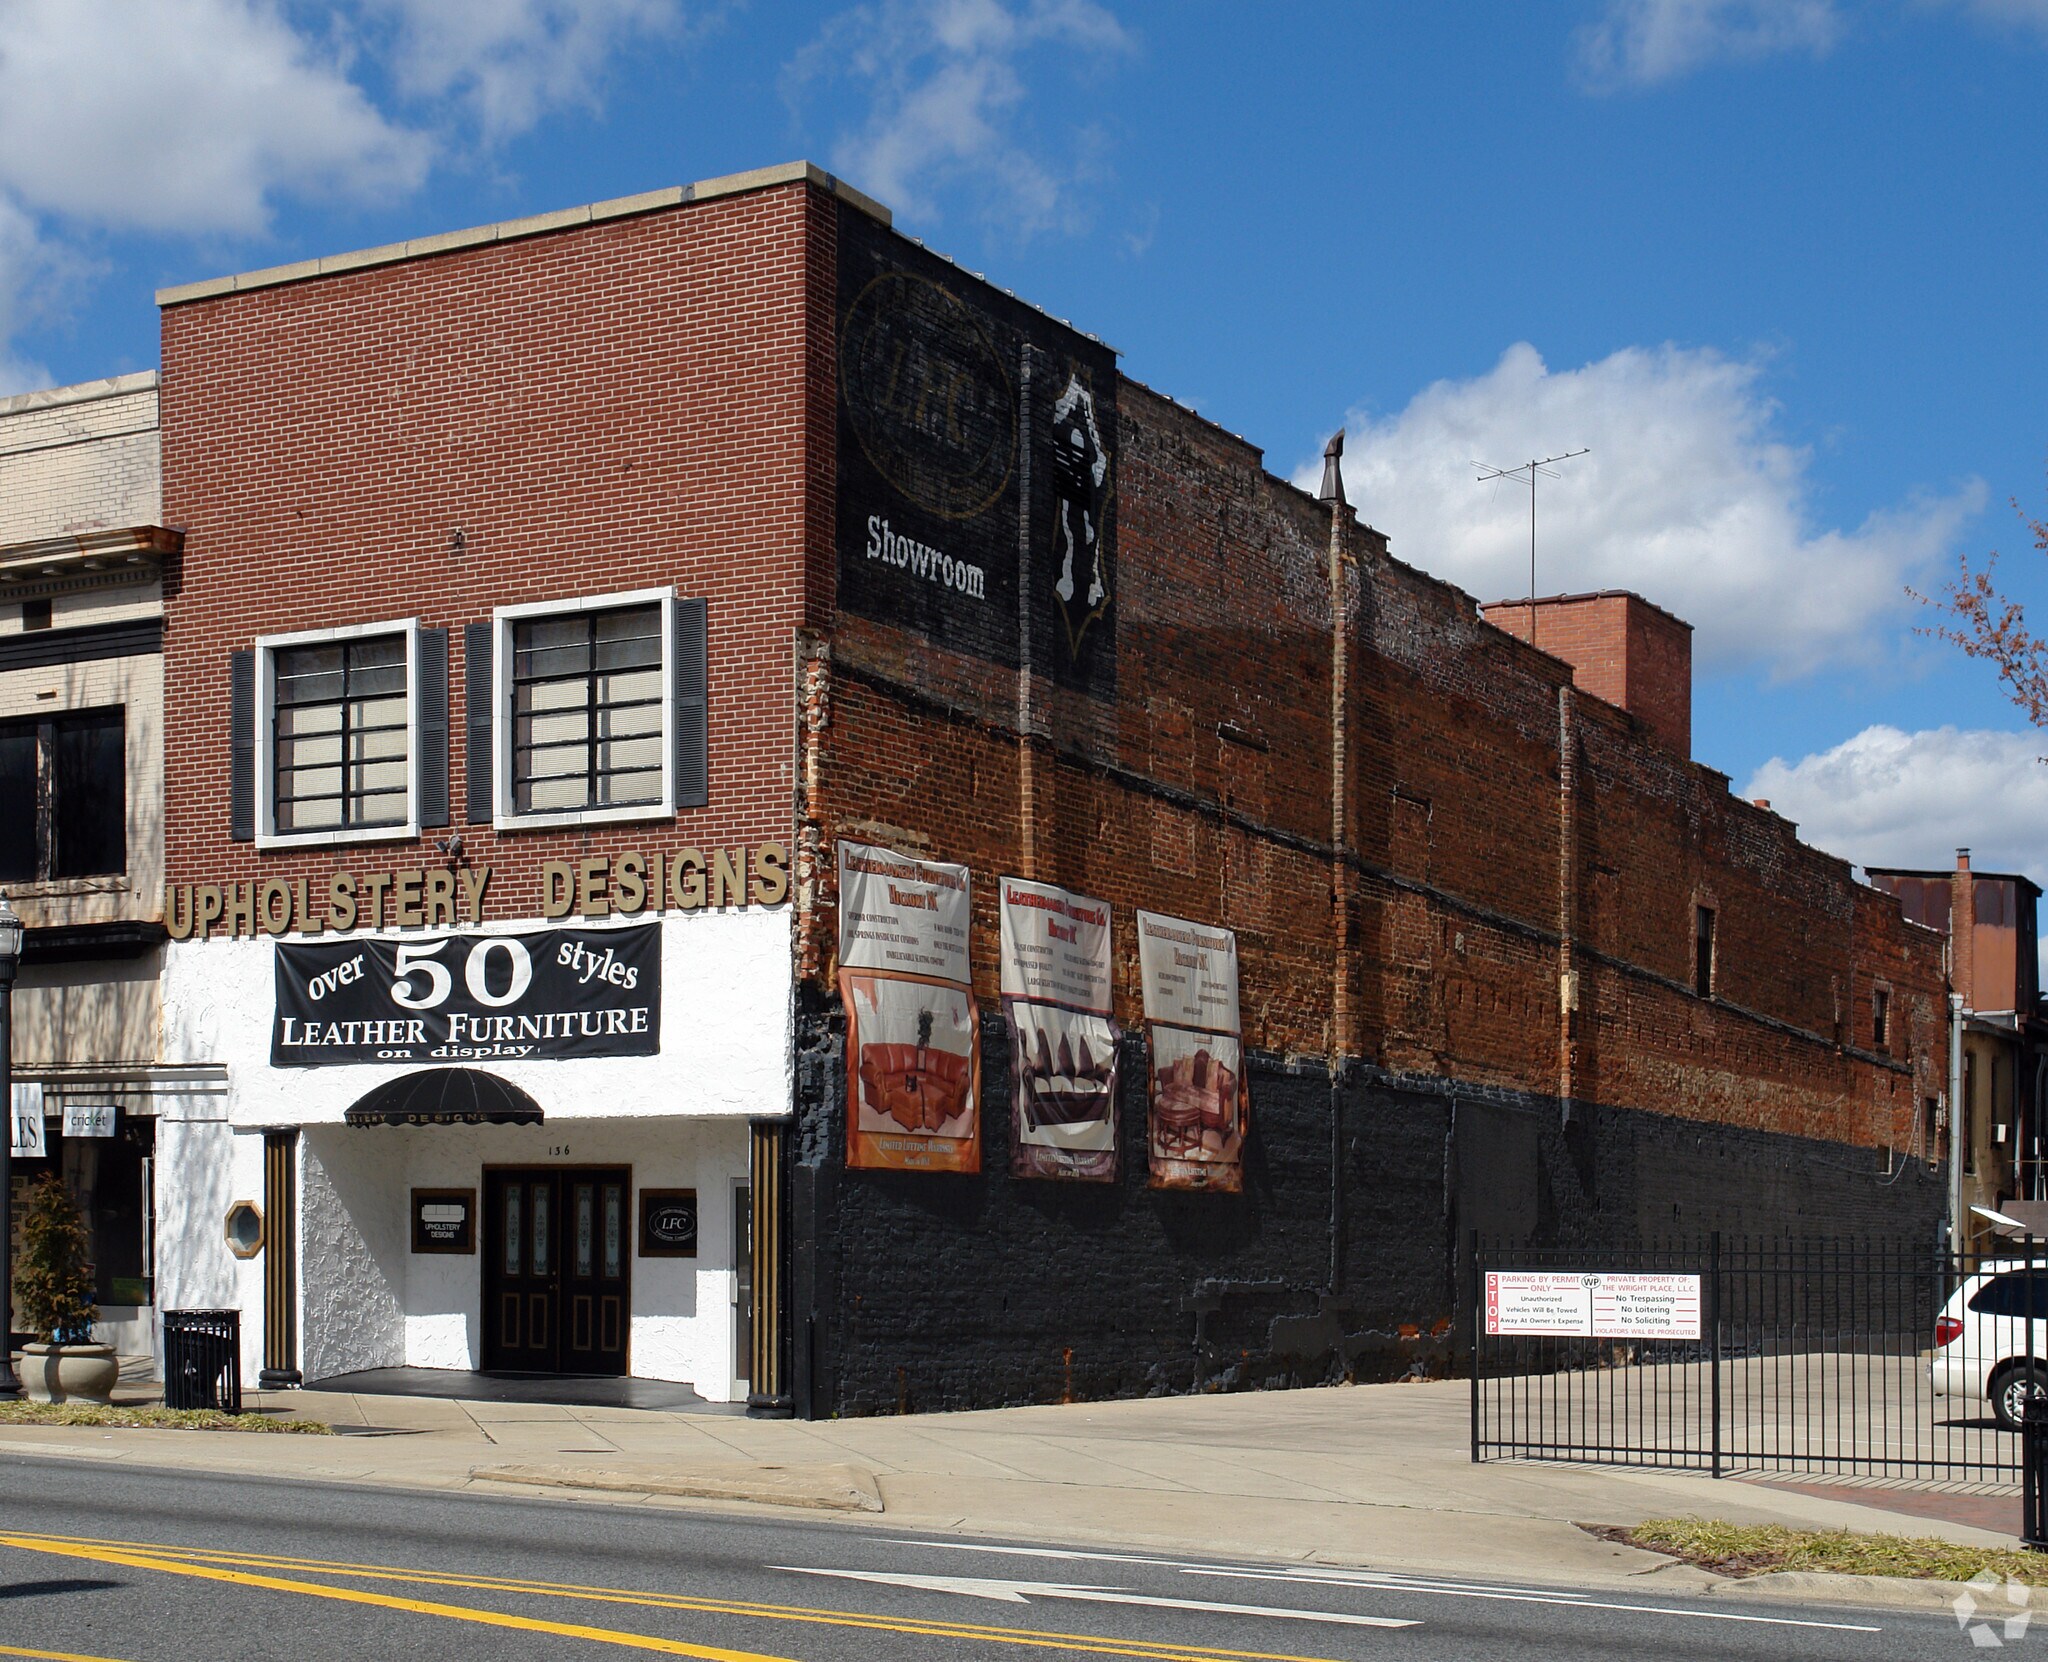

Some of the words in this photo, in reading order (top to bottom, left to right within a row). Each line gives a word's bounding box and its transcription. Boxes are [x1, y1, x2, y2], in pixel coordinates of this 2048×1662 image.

[866, 514, 985, 601] Showroom
[166, 866, 491, 939] UPHOLSTERY
[543, 842, 790, 918] DESIGNS
[308, 952, 365, 1001] over
[391, 937, 533, 1010] 50
[556, 940, 639, 990] styles
[281, 1017, 427, 1046] LEATHER
[445, 1007, 649, 1043] FURNITURE
[377, 1048, 412, 1058] on
[430, 1045, 534, 1060] display
[71, 1110, 107, 1126] cricket
[408, 1113, 488, 1123] DESIGNS
[548, 1144, 570, 1156] 136
[424, 1223, 461, 1231] UPHOLSTERY
[661, 1217, 687, 1230] LFC
[430, 1231, 455, 1239] DESIGNS
[1502, 1275, 1536, 1283] PARKING
[1538, 1275, 1549, 1283] BY
[1552, 1275, 1580, 1283] PERMIT
[1584, 1278, 1600, 1286] WP
[1606, 1275, 1637, 1283] PRIVATE
[1638, 1275, 1676, 1283] PROPERTY
[1602, 1284, 1616, 1292] THE
[1618, 1284, 1646, 1292] WRIGHT
[1488, 1275, 1498, 1332] STOP
[1630, 1294, 1675, 1305] Trespassing
[1506, 1306, 1530, 1314] Vehicles
[1532, 1306, 1545, 1314] Will
[1621, 1305, 1633, 1313] No
[1635, 1305, 1671, 1316] Loitering
[1500, 1317, 1518, 1325] Away
[1621, 1316, 1633, 1324] No
[1635, 1316, 1671, 1326] Soliciting
